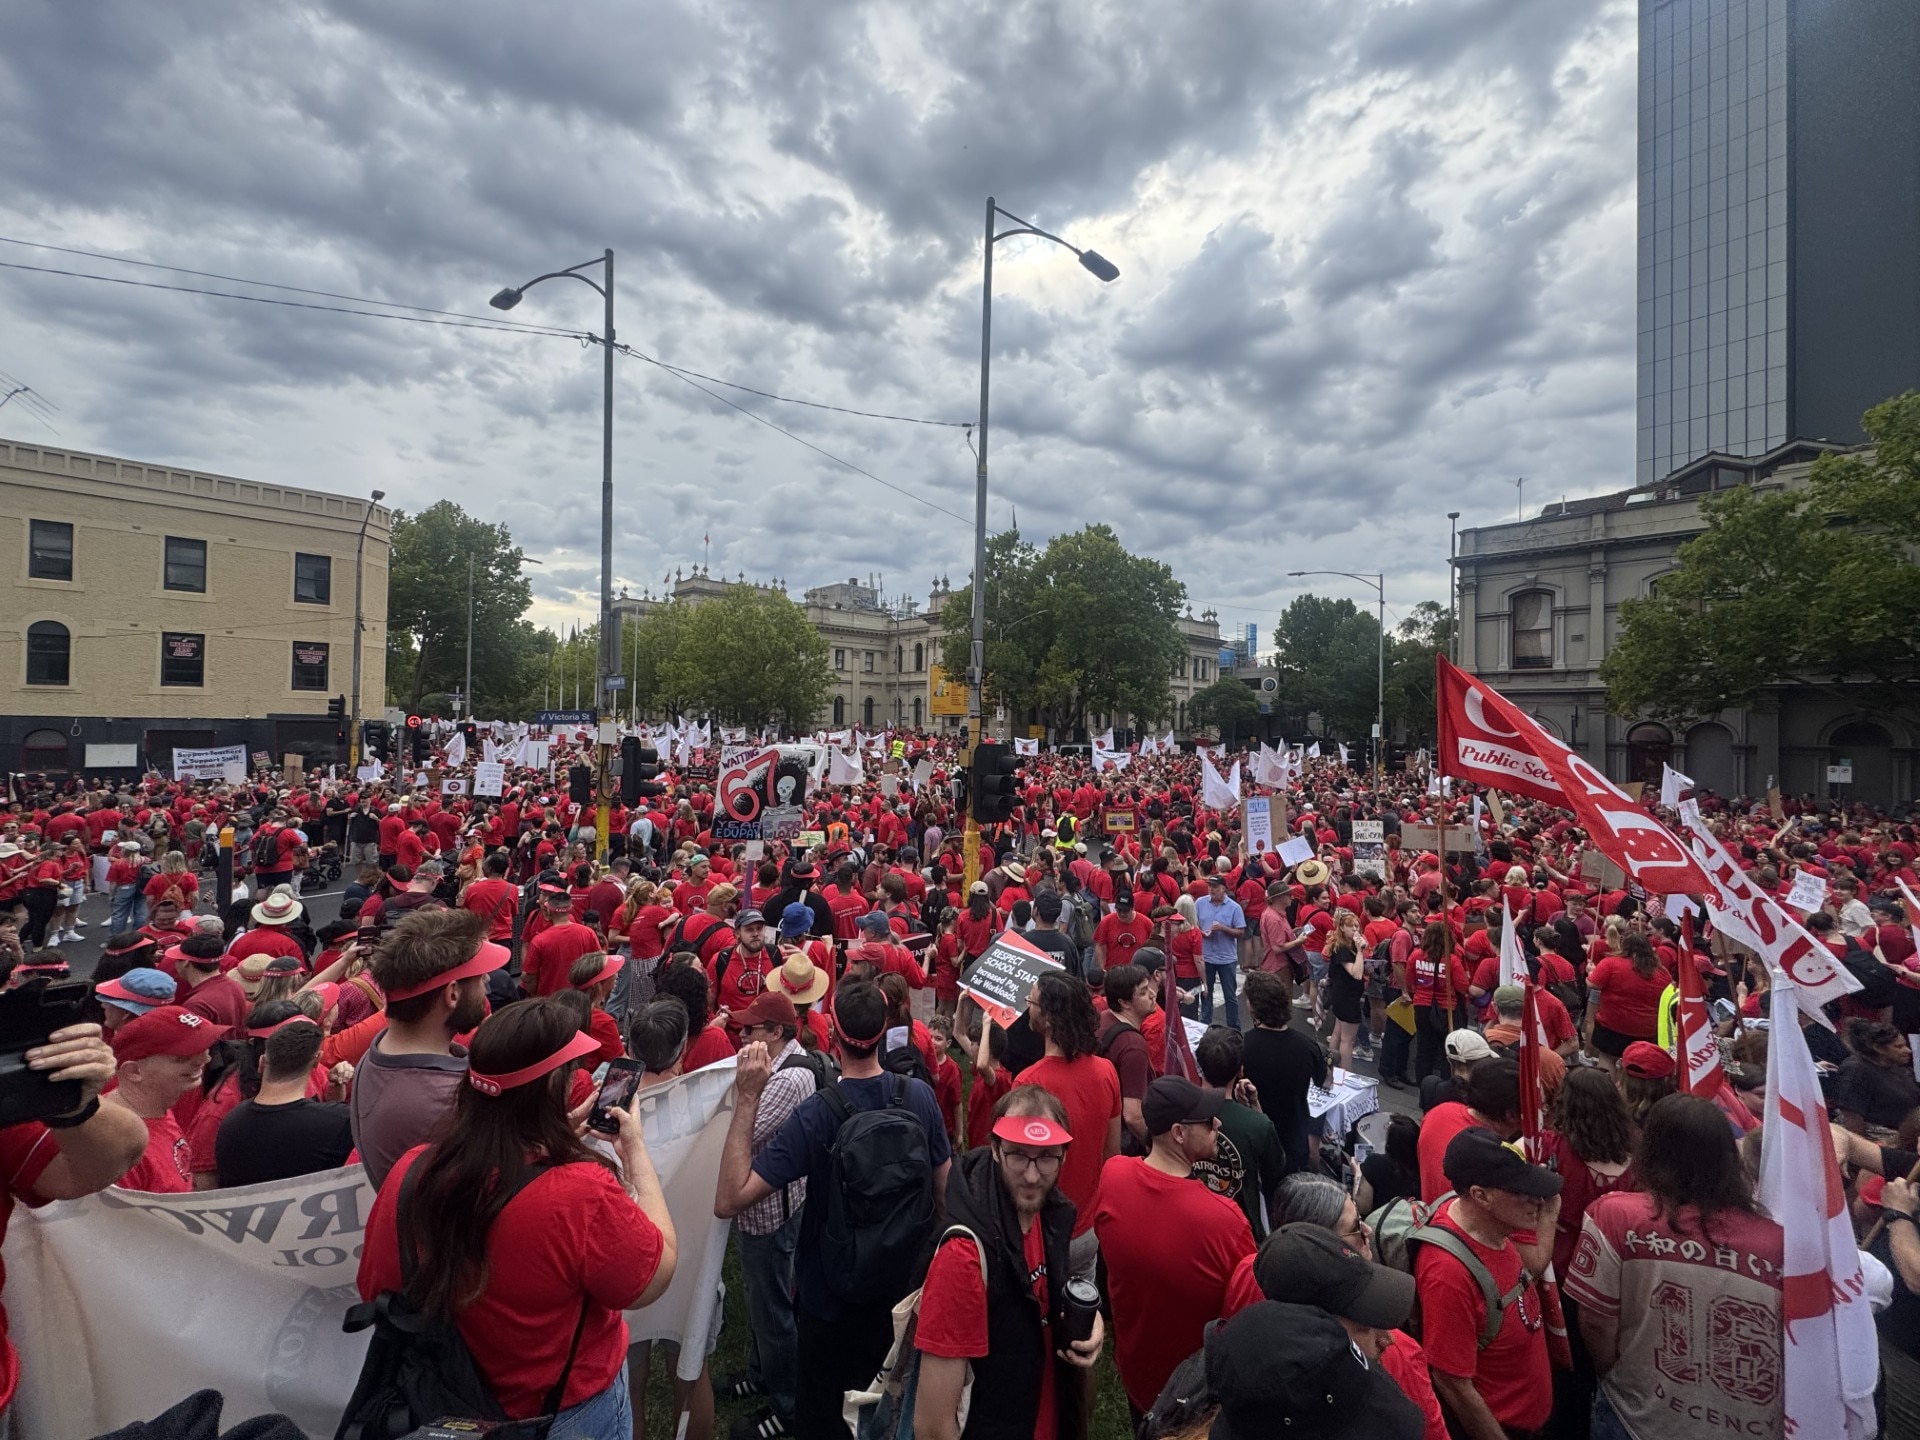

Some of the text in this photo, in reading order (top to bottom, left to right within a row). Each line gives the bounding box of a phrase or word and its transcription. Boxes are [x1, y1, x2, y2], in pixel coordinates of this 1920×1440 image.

[548, 713, 590, 721] Victoria St
[177, 751, 207, 759] Support
[722, 748, 760, 770] WAITING
[724, 746, 739, 757] ME
[1461, 745, 1556, 782] Public Sec
[720, 748, 780, 822] 67
[984, 957, 1016, 975] SCHOOL
[991, 948, 1026, 966] RESPECT
[976, 966, 1007, 985] Increased
[970, 974, 1017, 1003] Fair Workloads.
[1029, 1127, 1046, 1135] AEU
[1654, 1383, 1776, 1436] DECENCY
